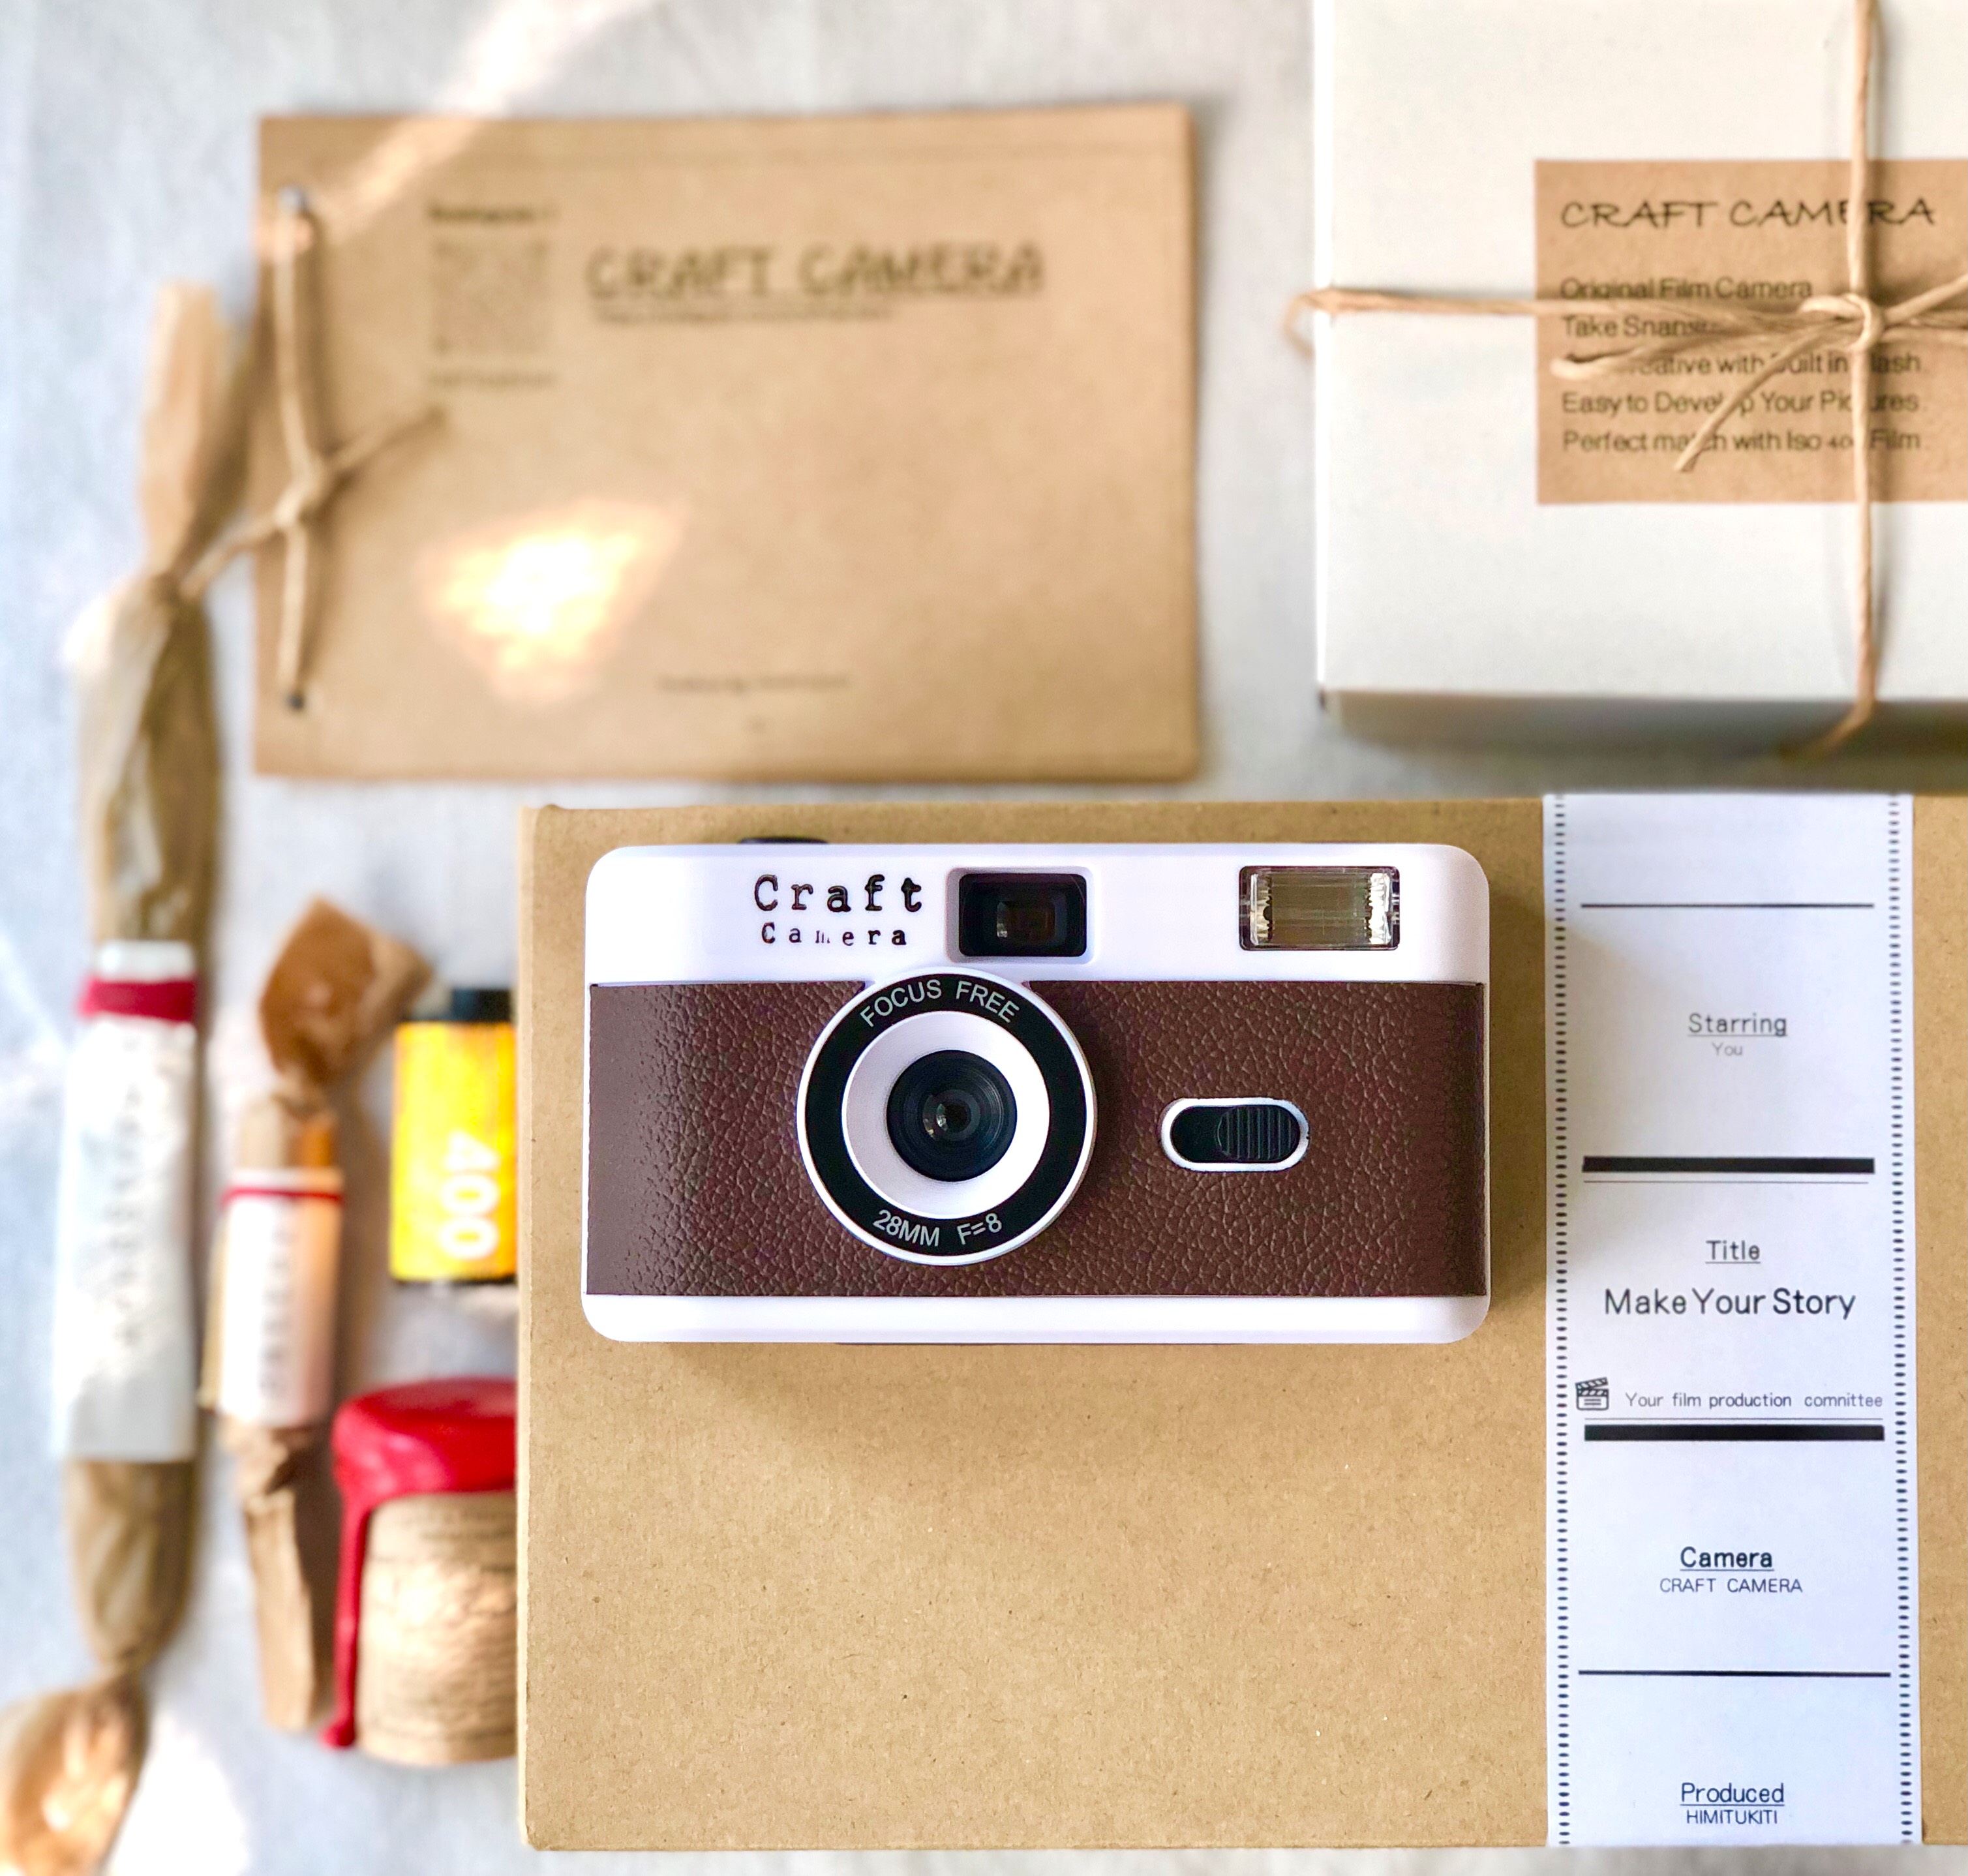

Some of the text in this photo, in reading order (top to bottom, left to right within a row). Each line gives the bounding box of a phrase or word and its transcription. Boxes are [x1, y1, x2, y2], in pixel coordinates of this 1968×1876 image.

[1560, 200, 1718, 229] CRAFT
[588, 237, 1046, 303] CRAFT CAMERA
[1560, 277, 1811, 300] Original Film Camera
[1563, 314, 1618, 337] Take
[1718, 354, 1764, 374] with
[1770, 351, 1823, 374] uilt
[1827, 351, 1849, 374] in
[1870, 351, 1920, 374] lash
[1562, 391, 1621, 417] Easy
[1626, 393, 1648, 413] to
[1654, 391, 1755, 416] Develp
[1761, 391, 1813, 413] Your
[1562, 428, 1920, 451] Perfect mah with Iso 40 Film
[753, 873, 922, 913] Craft
[860, 979, 1020, 1028] FOCUS FREE
[1688, 1012, 1787, 1037] Starring
[1712, 1042, 1744, 1057] You
[437, 1129, 501, 1260] 400
[873, 1209, 1003, 1247] 28MM F=8
[1706, 1239, 1761, 1261] Title
[1605, 1287, 1856, 1320] Make Your Story
[1625, 1392, 1663, 1408] Your
[1672, 1392, 1702, 1408] film
[1709, 1392, 1793, 1410] production
[1680, 1546, 1773, 1568] Camera
[1659, 1578, 1803, 1594] CRAFT CAMERA
[1680, 1781, 1785, 1804] Produced
[1686, 1809, 1778, 1826] HIMITUKITI
